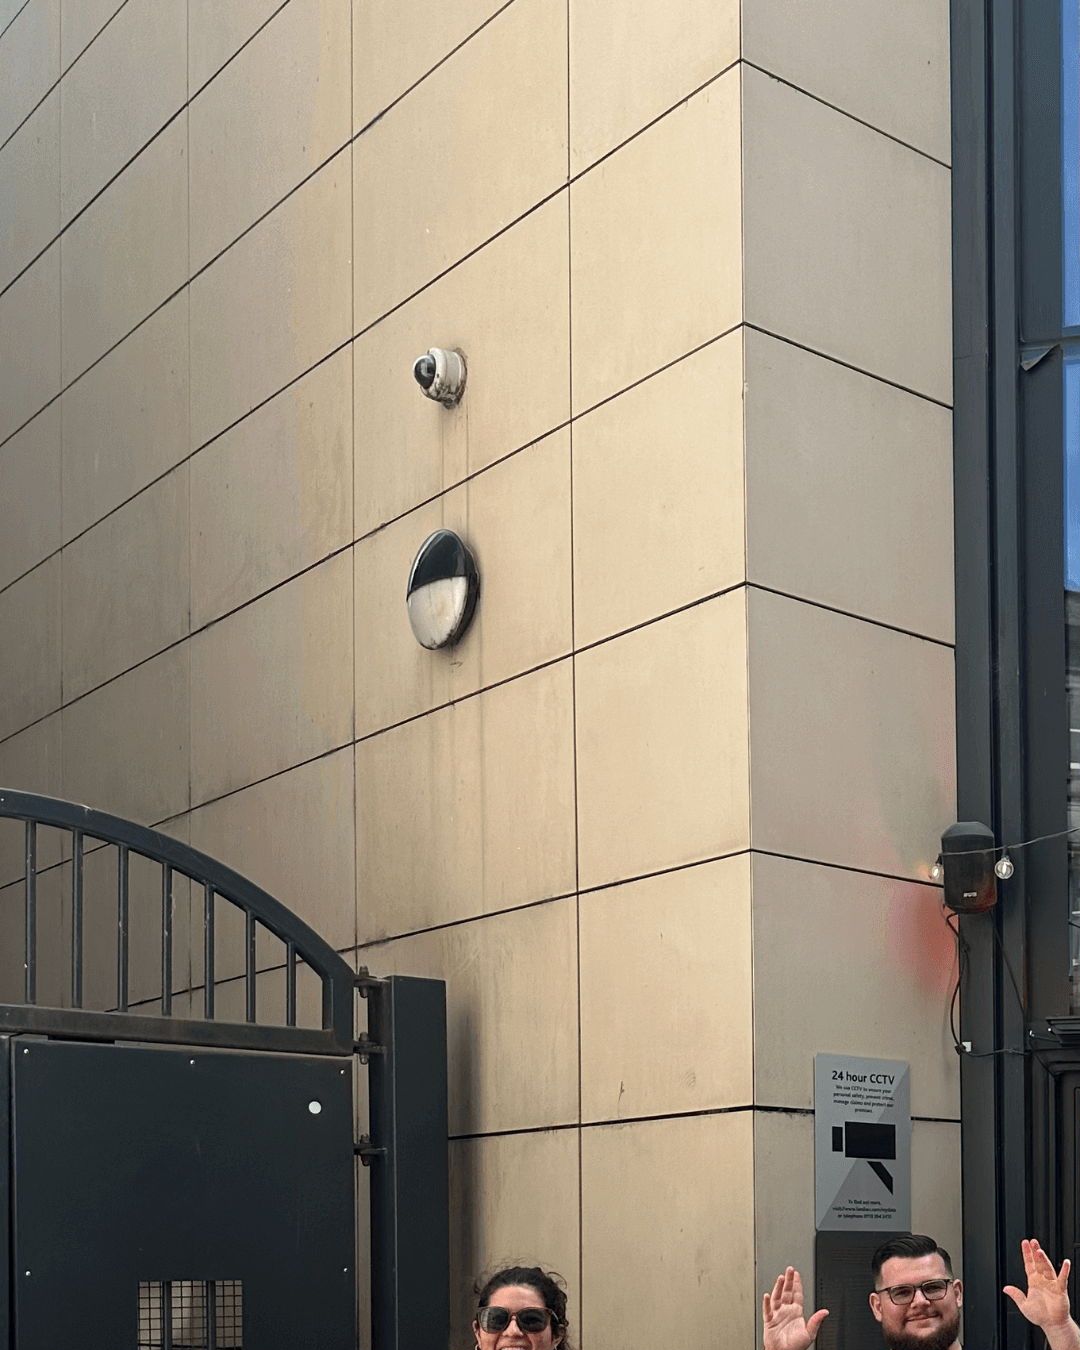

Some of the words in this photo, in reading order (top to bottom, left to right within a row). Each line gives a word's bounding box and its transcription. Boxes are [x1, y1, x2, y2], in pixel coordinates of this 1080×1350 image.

[832, 1070, 844, 1081] 24
[846, 1071, 867, 1082] hour
[869, 1073, 895, 1085] CCTV
